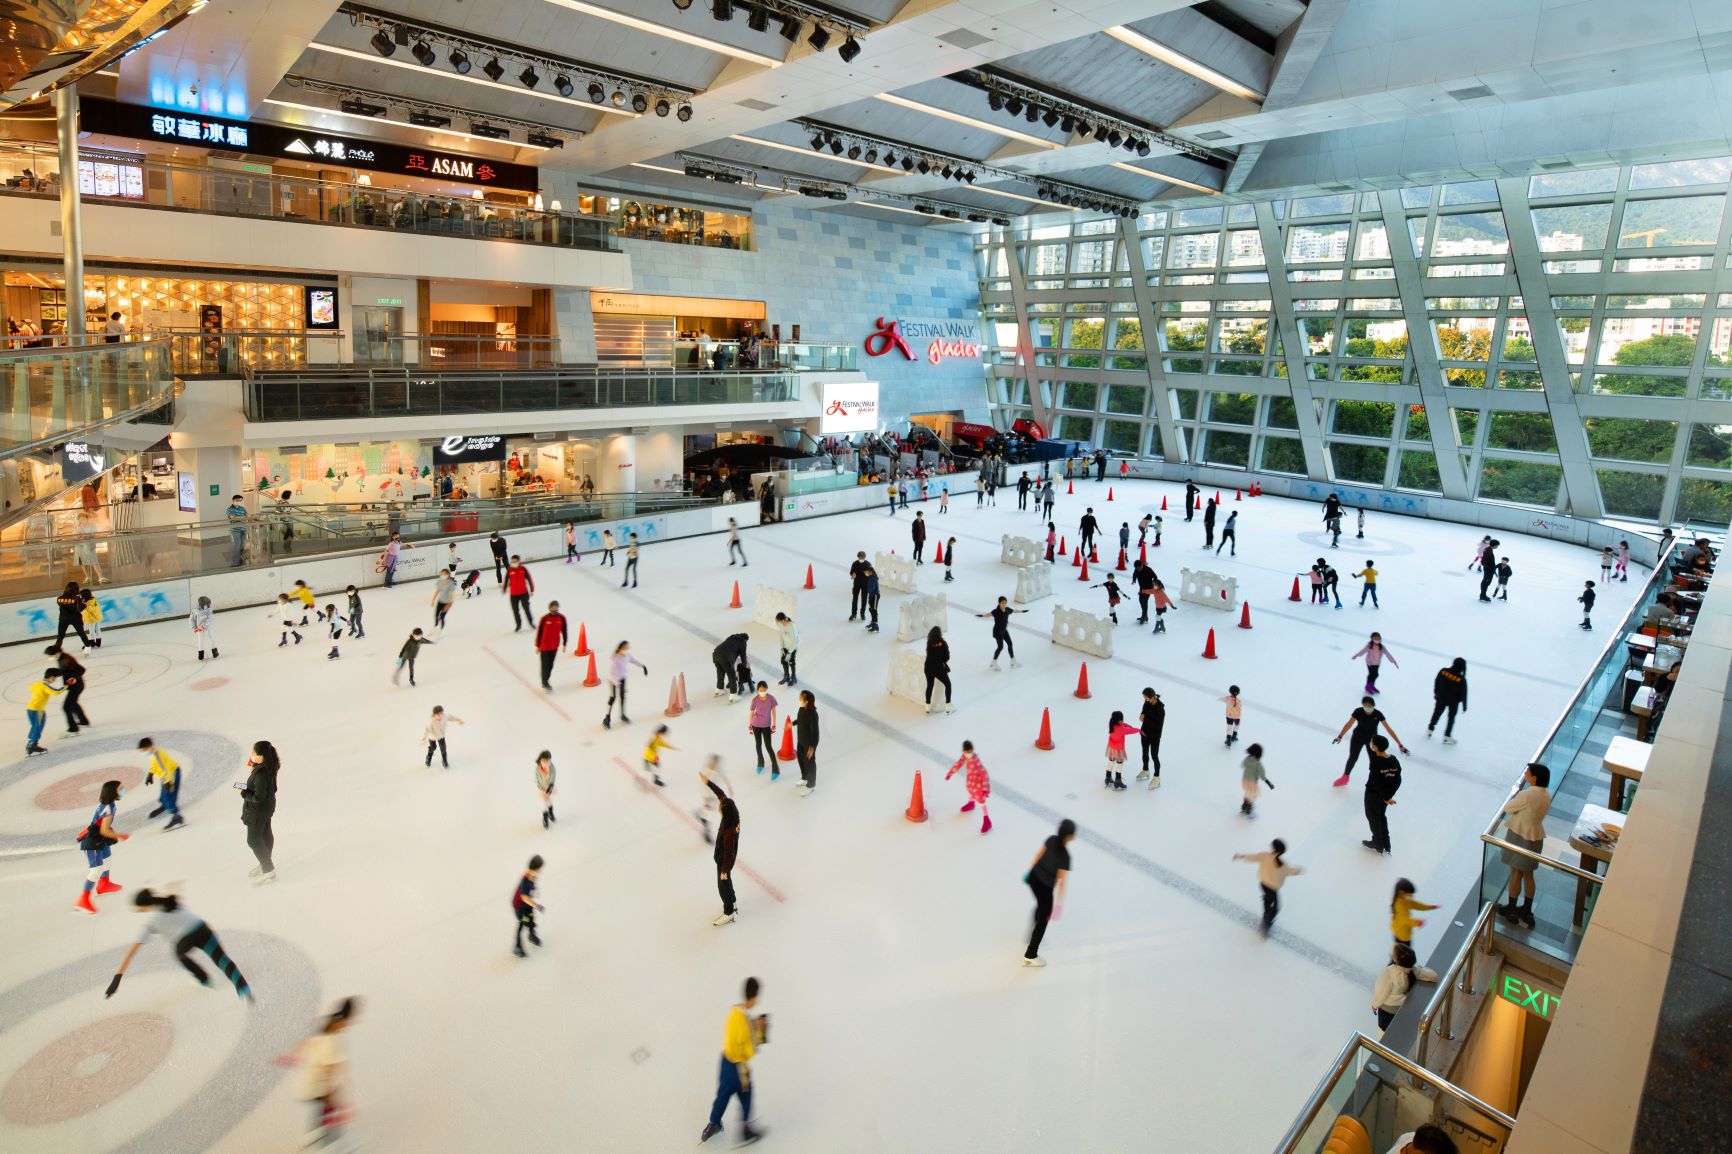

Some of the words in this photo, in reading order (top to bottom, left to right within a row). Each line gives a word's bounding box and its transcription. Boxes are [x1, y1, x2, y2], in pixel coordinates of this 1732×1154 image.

[152, 114, 247, 147] 敏華冰廳
[431, 157, 474, 178] ASAM
[900, 320, 945, 338] FESTIVAL
[945, 322, 975, 338] WALK
[928, 338, 980, 365] glacier
[842, 400, 862, 408] FESTIVAL
